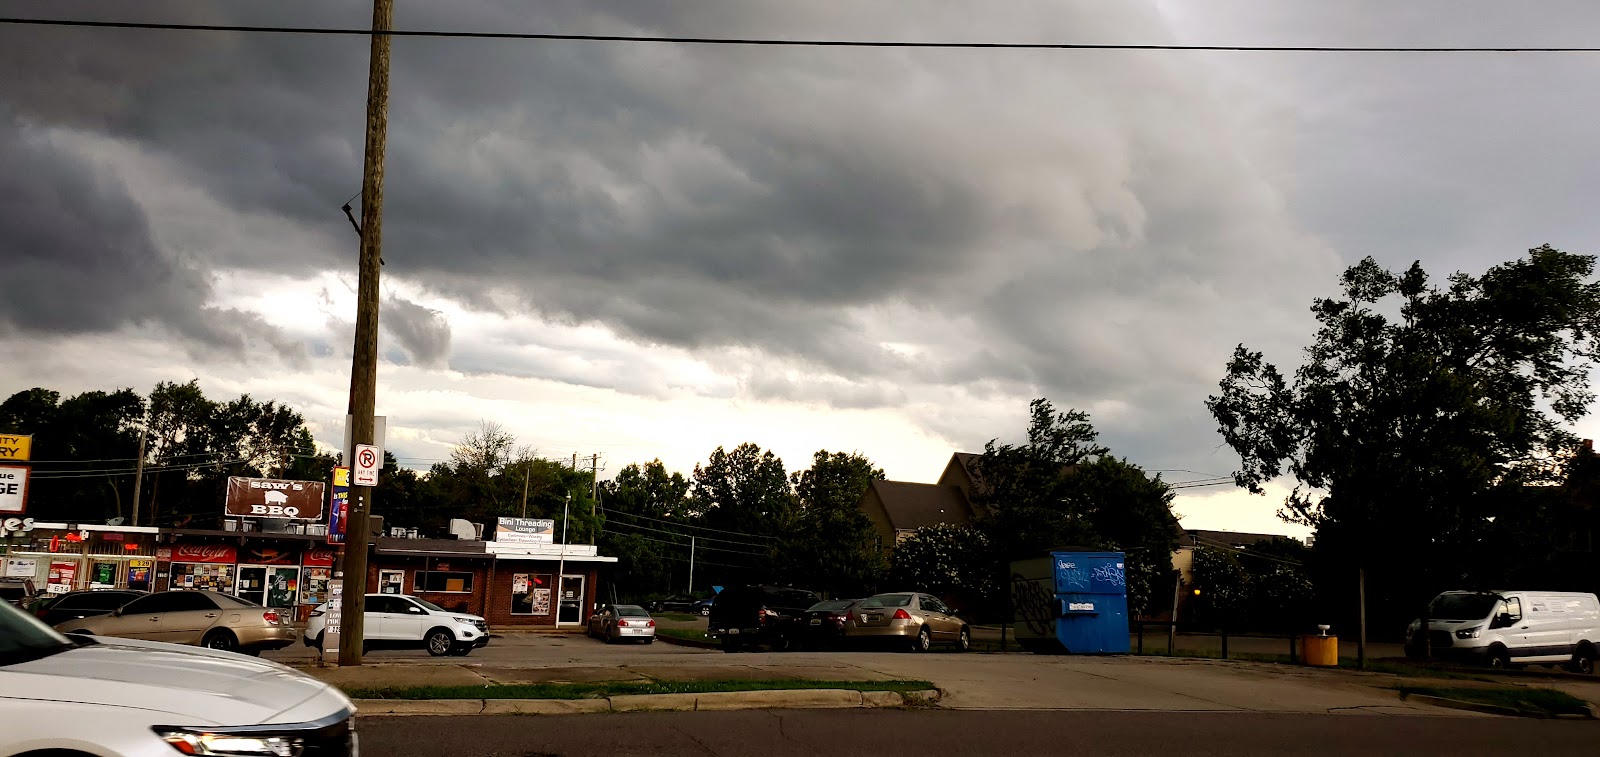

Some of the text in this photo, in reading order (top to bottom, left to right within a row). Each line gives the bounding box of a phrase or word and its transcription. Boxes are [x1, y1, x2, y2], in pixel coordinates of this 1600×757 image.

[250, 504, 299, 518] BBQ
[0, 518, 34, 531] es
[515, 518, 552, 528] Threading
